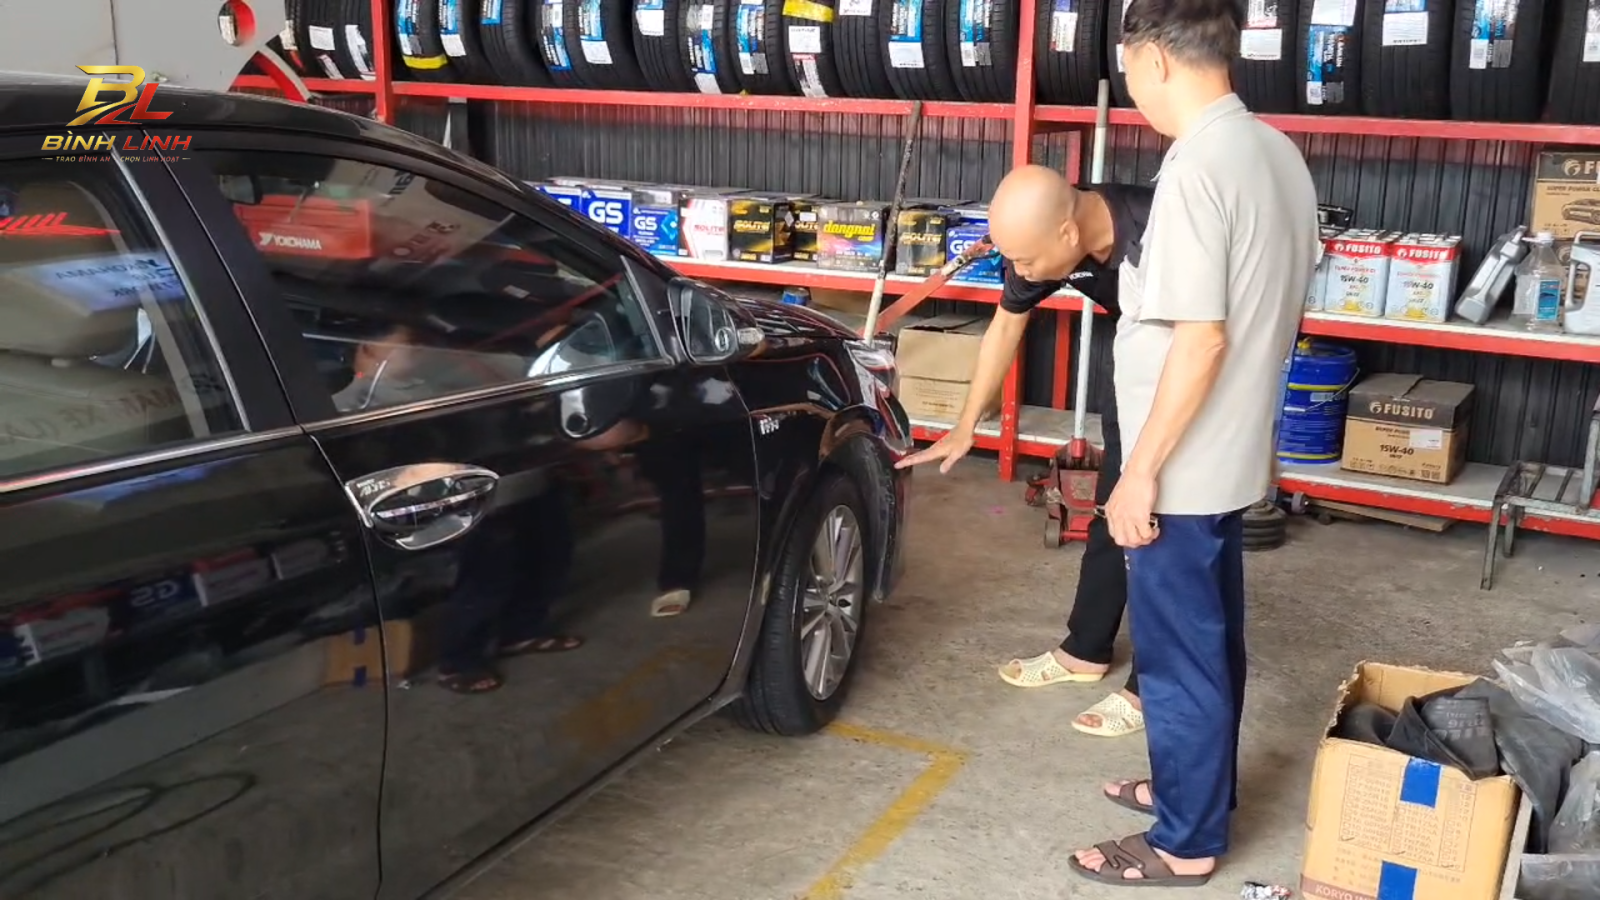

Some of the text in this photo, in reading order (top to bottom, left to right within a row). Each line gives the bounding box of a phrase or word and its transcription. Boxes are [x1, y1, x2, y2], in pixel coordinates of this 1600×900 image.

[588, 201, 623, 225] GS
[634, 216, 657, 231] GS
[1345, 243, 1381, 254] FUSITO
[1384, 403, 1434, 419] FUSITO
[1380, 444, 1414, 455] 15W-40
